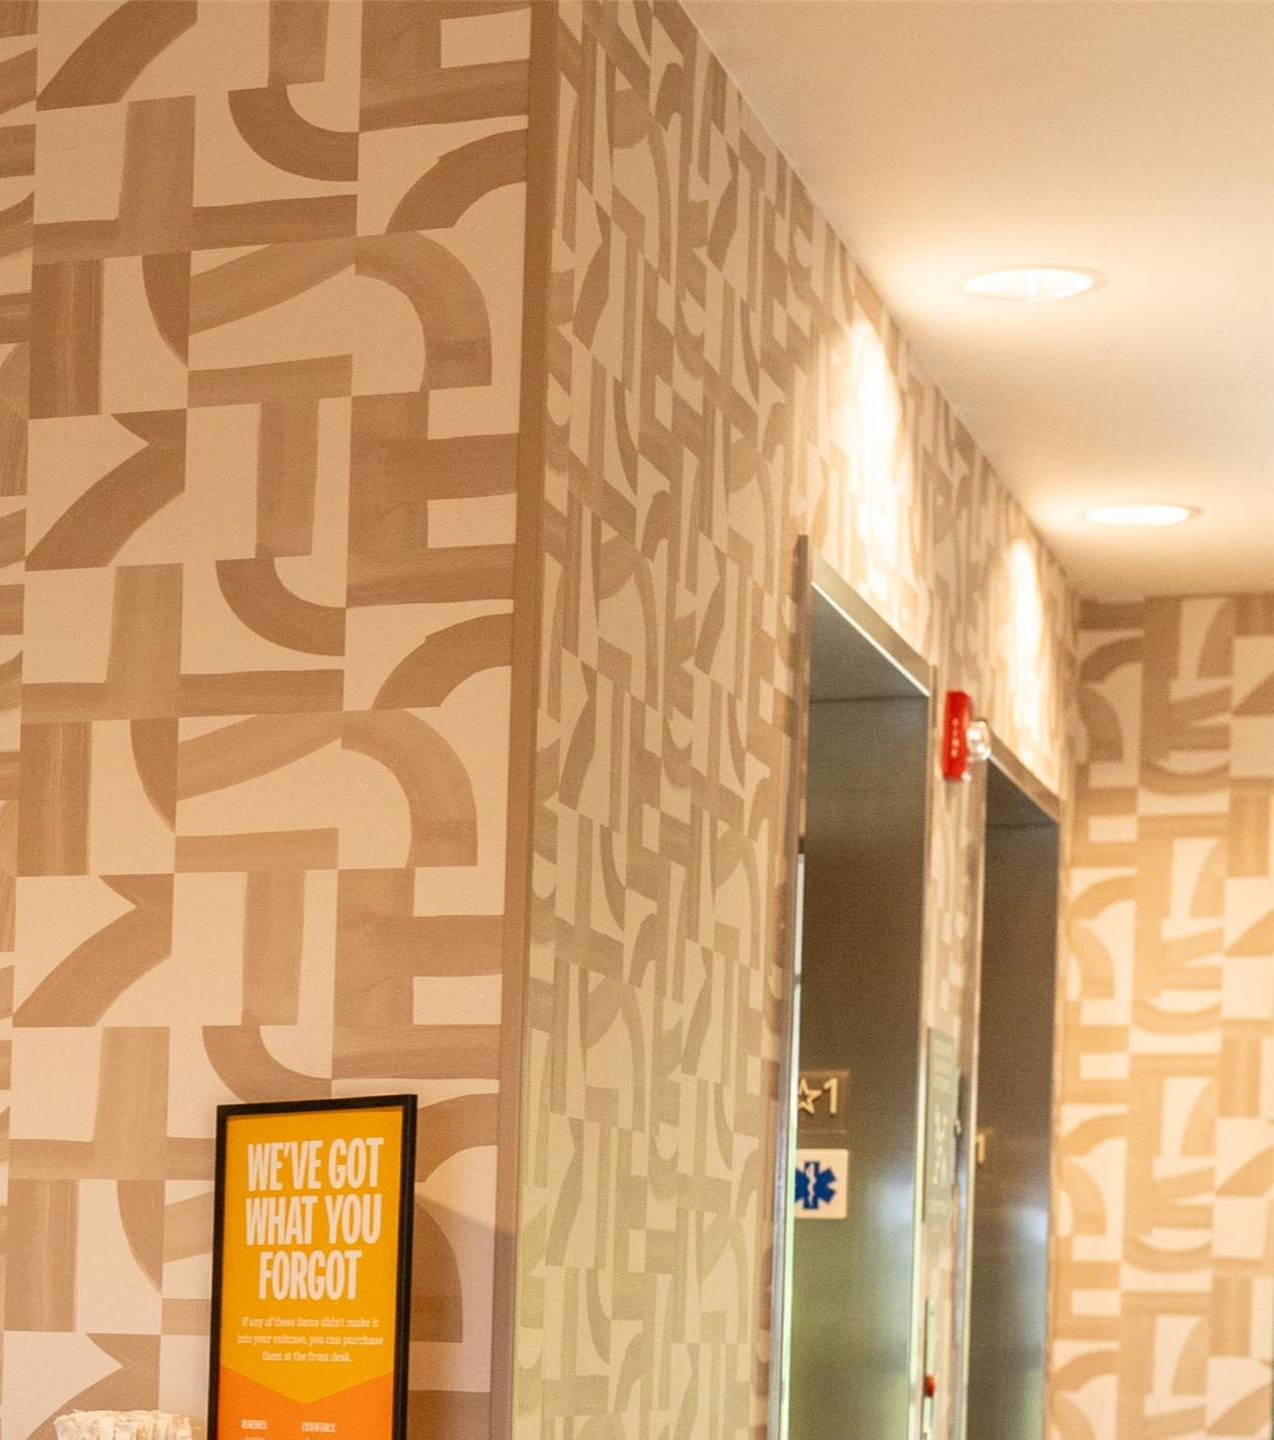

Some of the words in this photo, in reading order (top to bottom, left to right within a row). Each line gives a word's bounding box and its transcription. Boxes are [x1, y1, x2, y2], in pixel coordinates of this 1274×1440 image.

[823, 1078, 838, 1114] 1
[247, 1140, 323, 1191] WE'VE
[328, 1137, 384, 1189] GOT
[246, 1195, 318, 1246] WHAT
[324, 1193, 382, 1244] YOU
[259, 1250, 362, 1300] FORGOT
